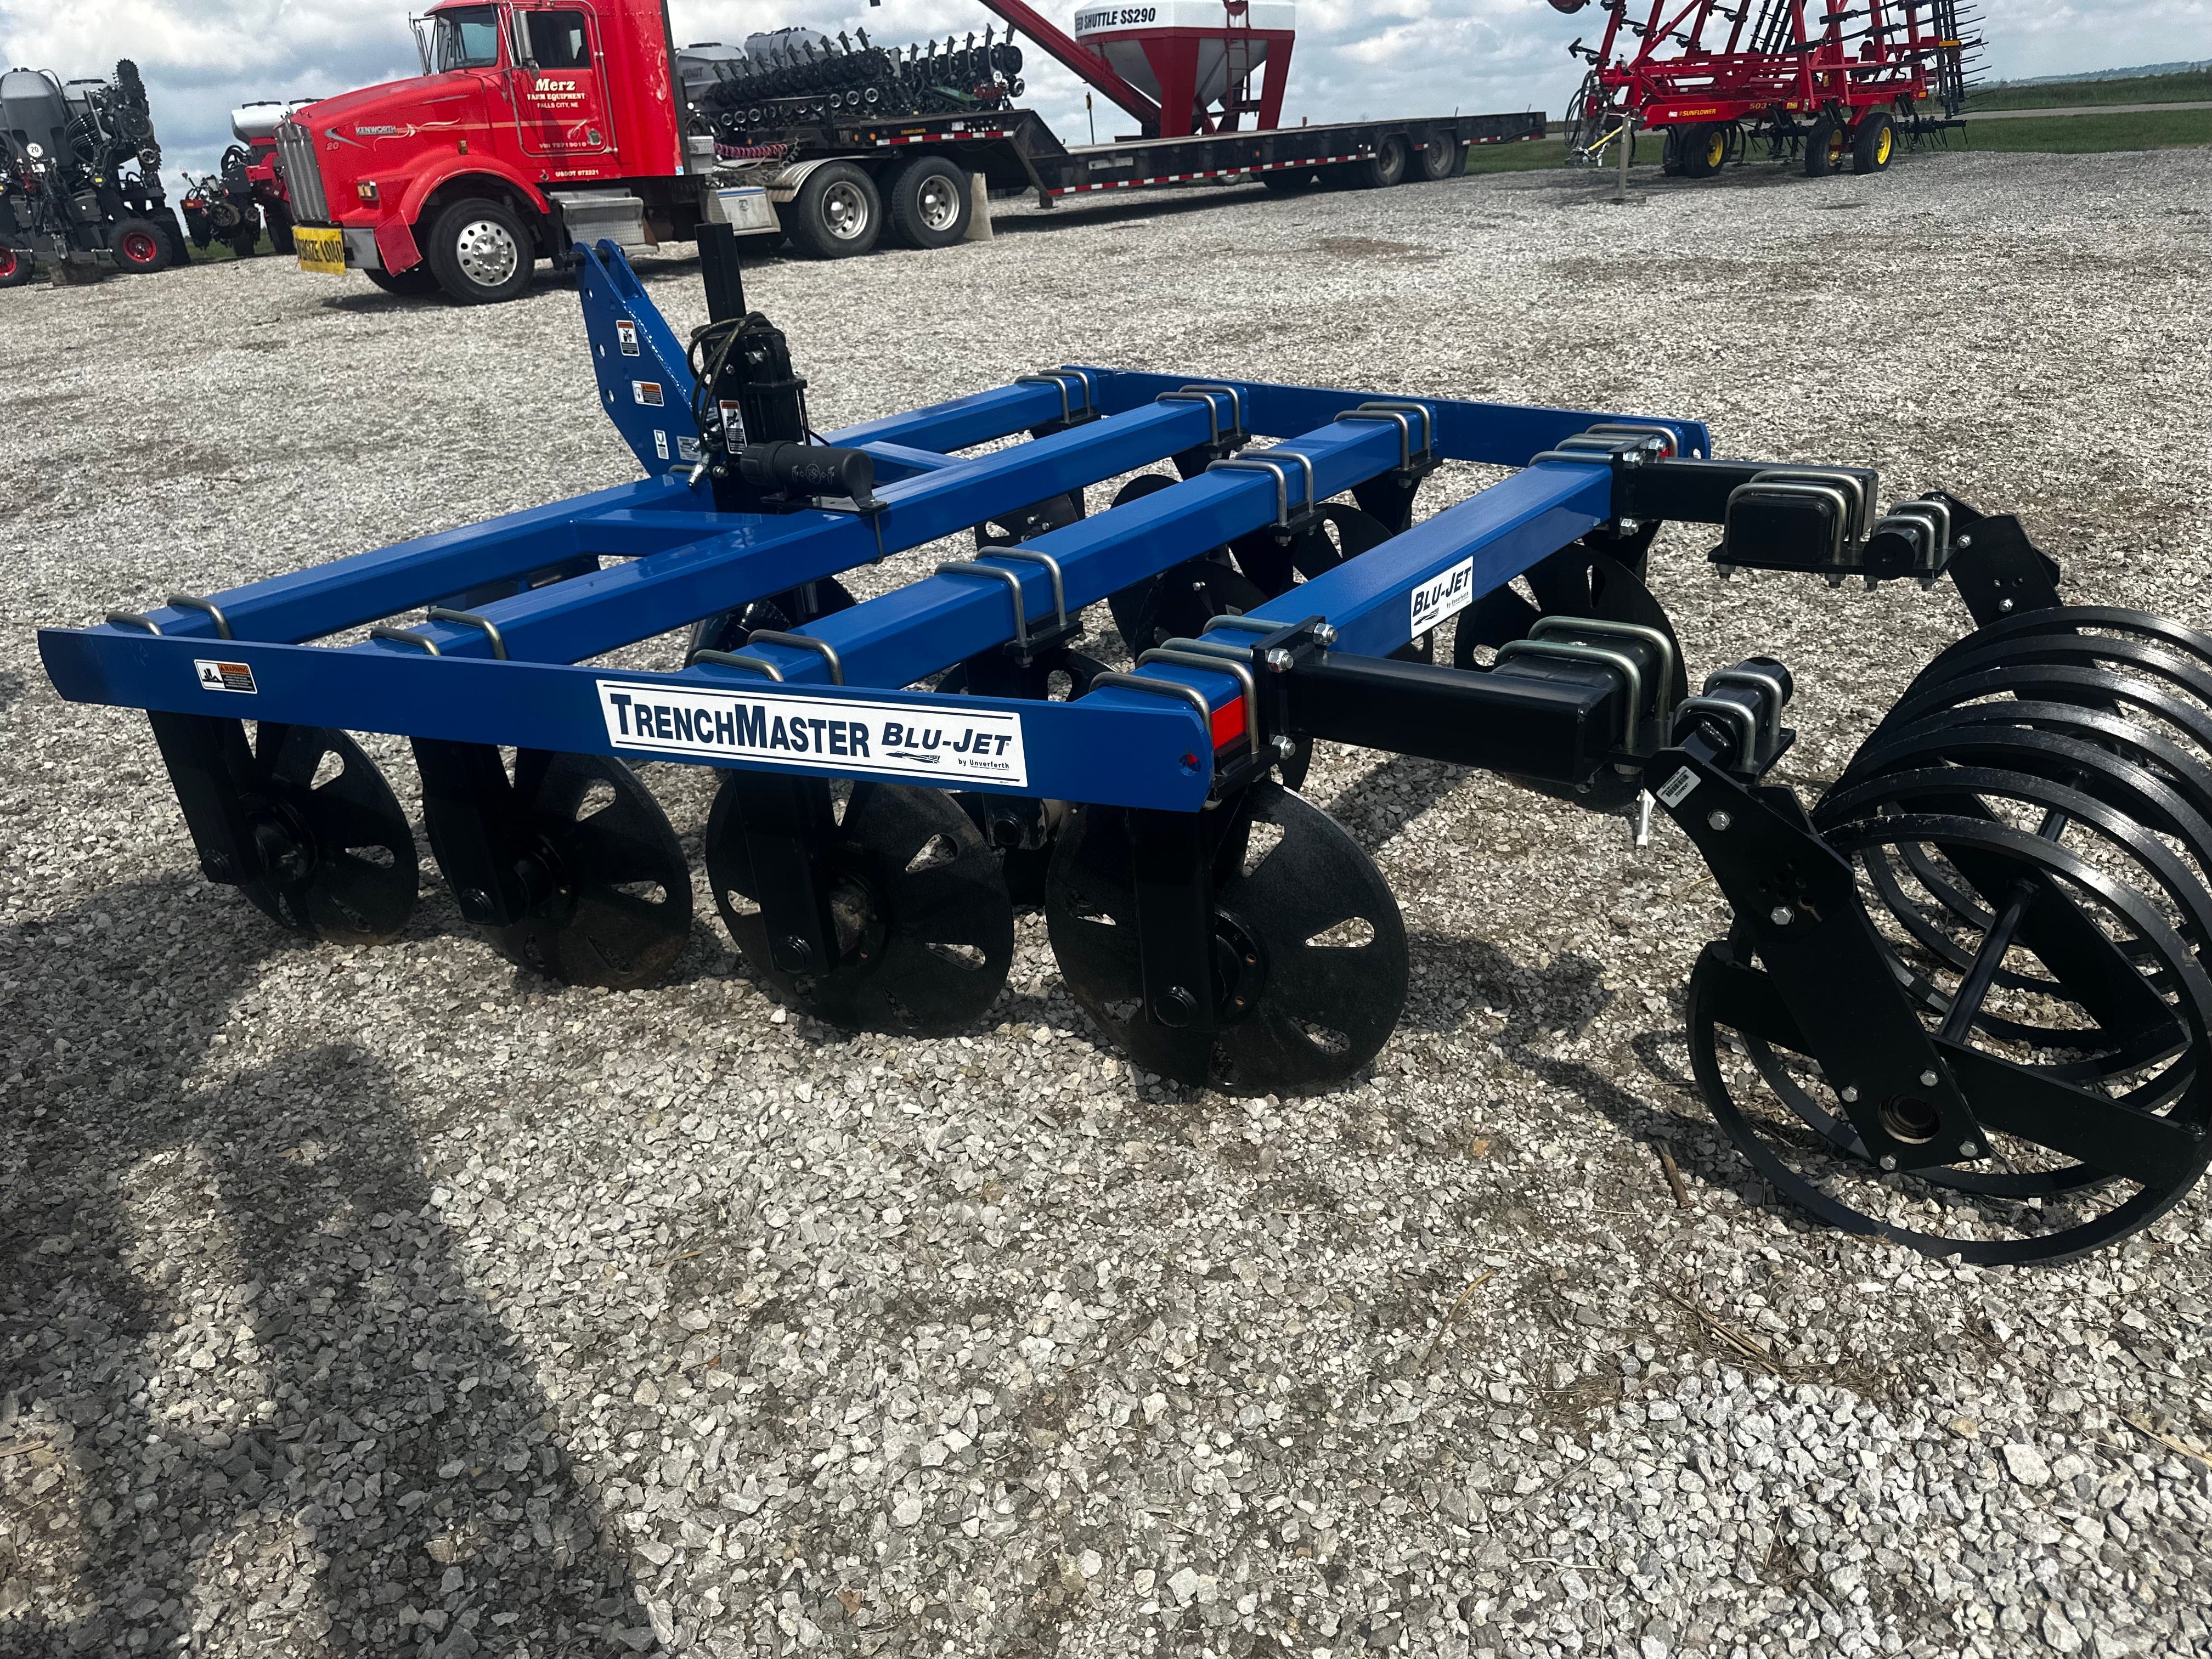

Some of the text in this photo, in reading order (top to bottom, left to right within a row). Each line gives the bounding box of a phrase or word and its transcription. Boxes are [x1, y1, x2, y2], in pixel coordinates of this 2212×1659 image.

[1084, 11, 1118, 29] SHUTTLE
[1120, 8, 1156, 25] SS290
[535, 78, 575, 92] Merz
[546, 93, 585, 101] EQUIPMENT
[356, 126, 396, 135] KENWORTH
[326, 142, 340, 151] 20
[320, 240, 343, 263] LOAD
[1413, 566, 1472, 618] BLU-JET
[225, 665, 249, 674] WARNING
[882, 722, 1012, 756] BLU-JET
[958, 758, 967, 766] by
